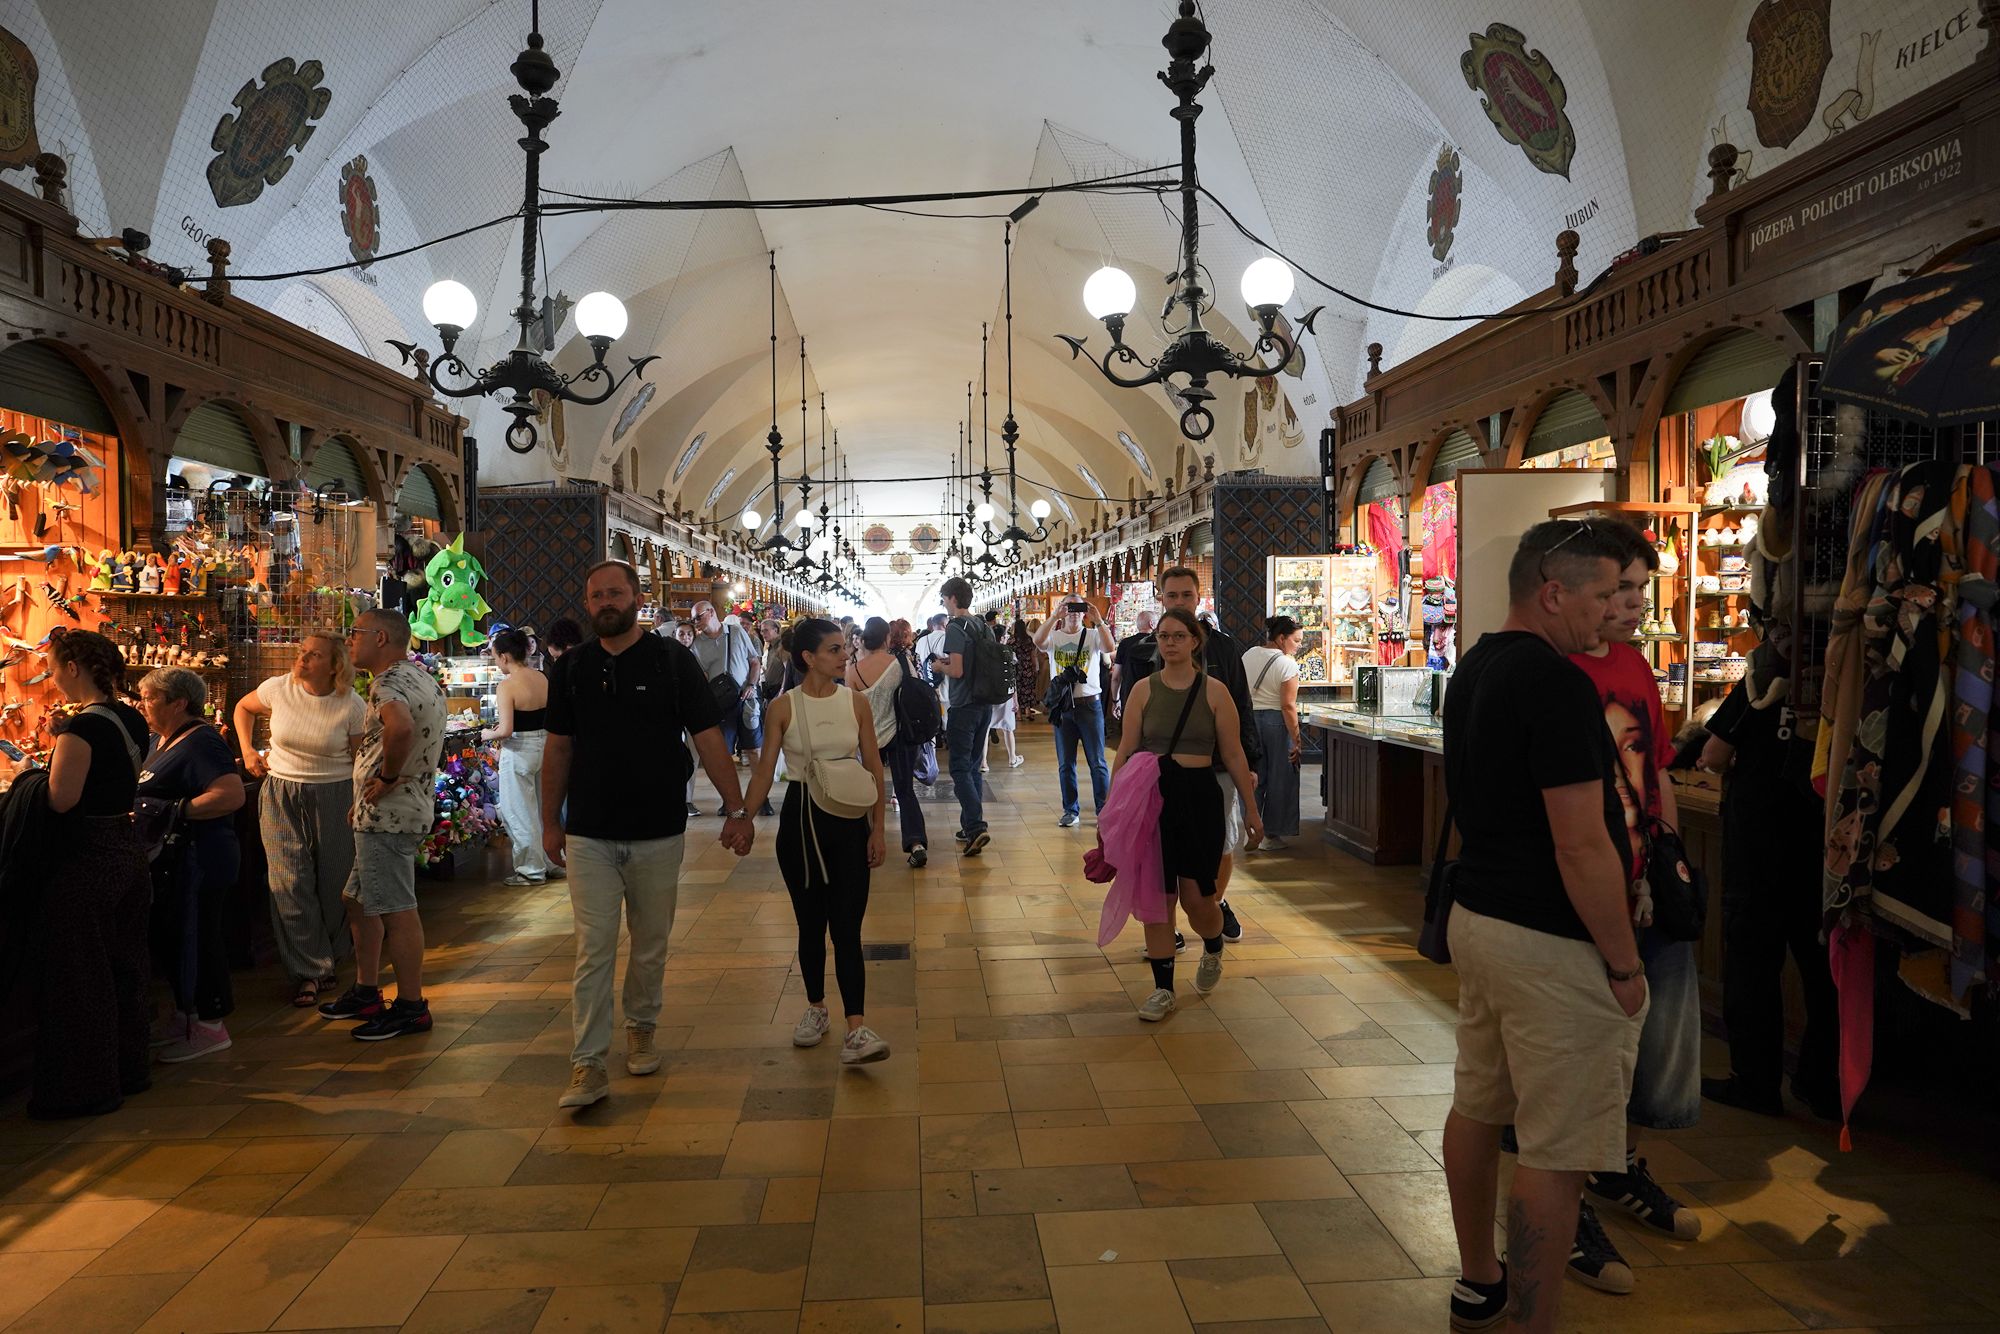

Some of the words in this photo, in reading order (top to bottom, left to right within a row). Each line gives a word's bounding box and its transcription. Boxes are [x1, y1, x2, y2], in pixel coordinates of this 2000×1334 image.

[1895, 8, 1971, 70] KIELCE
[1933, 161, 1962, 185] 1922
[1750, 214, 1796, 252] JÓZEFA
[1801, 182, 1865, 226] POLICHT
[1868, 138, 1963, 195] OLEKSOWA
[1565, 197, 1600, 230] LUBLIN
[181, 215, 221, 249] GŁOG
[1064, 650, 1090, 661] ANGLES
